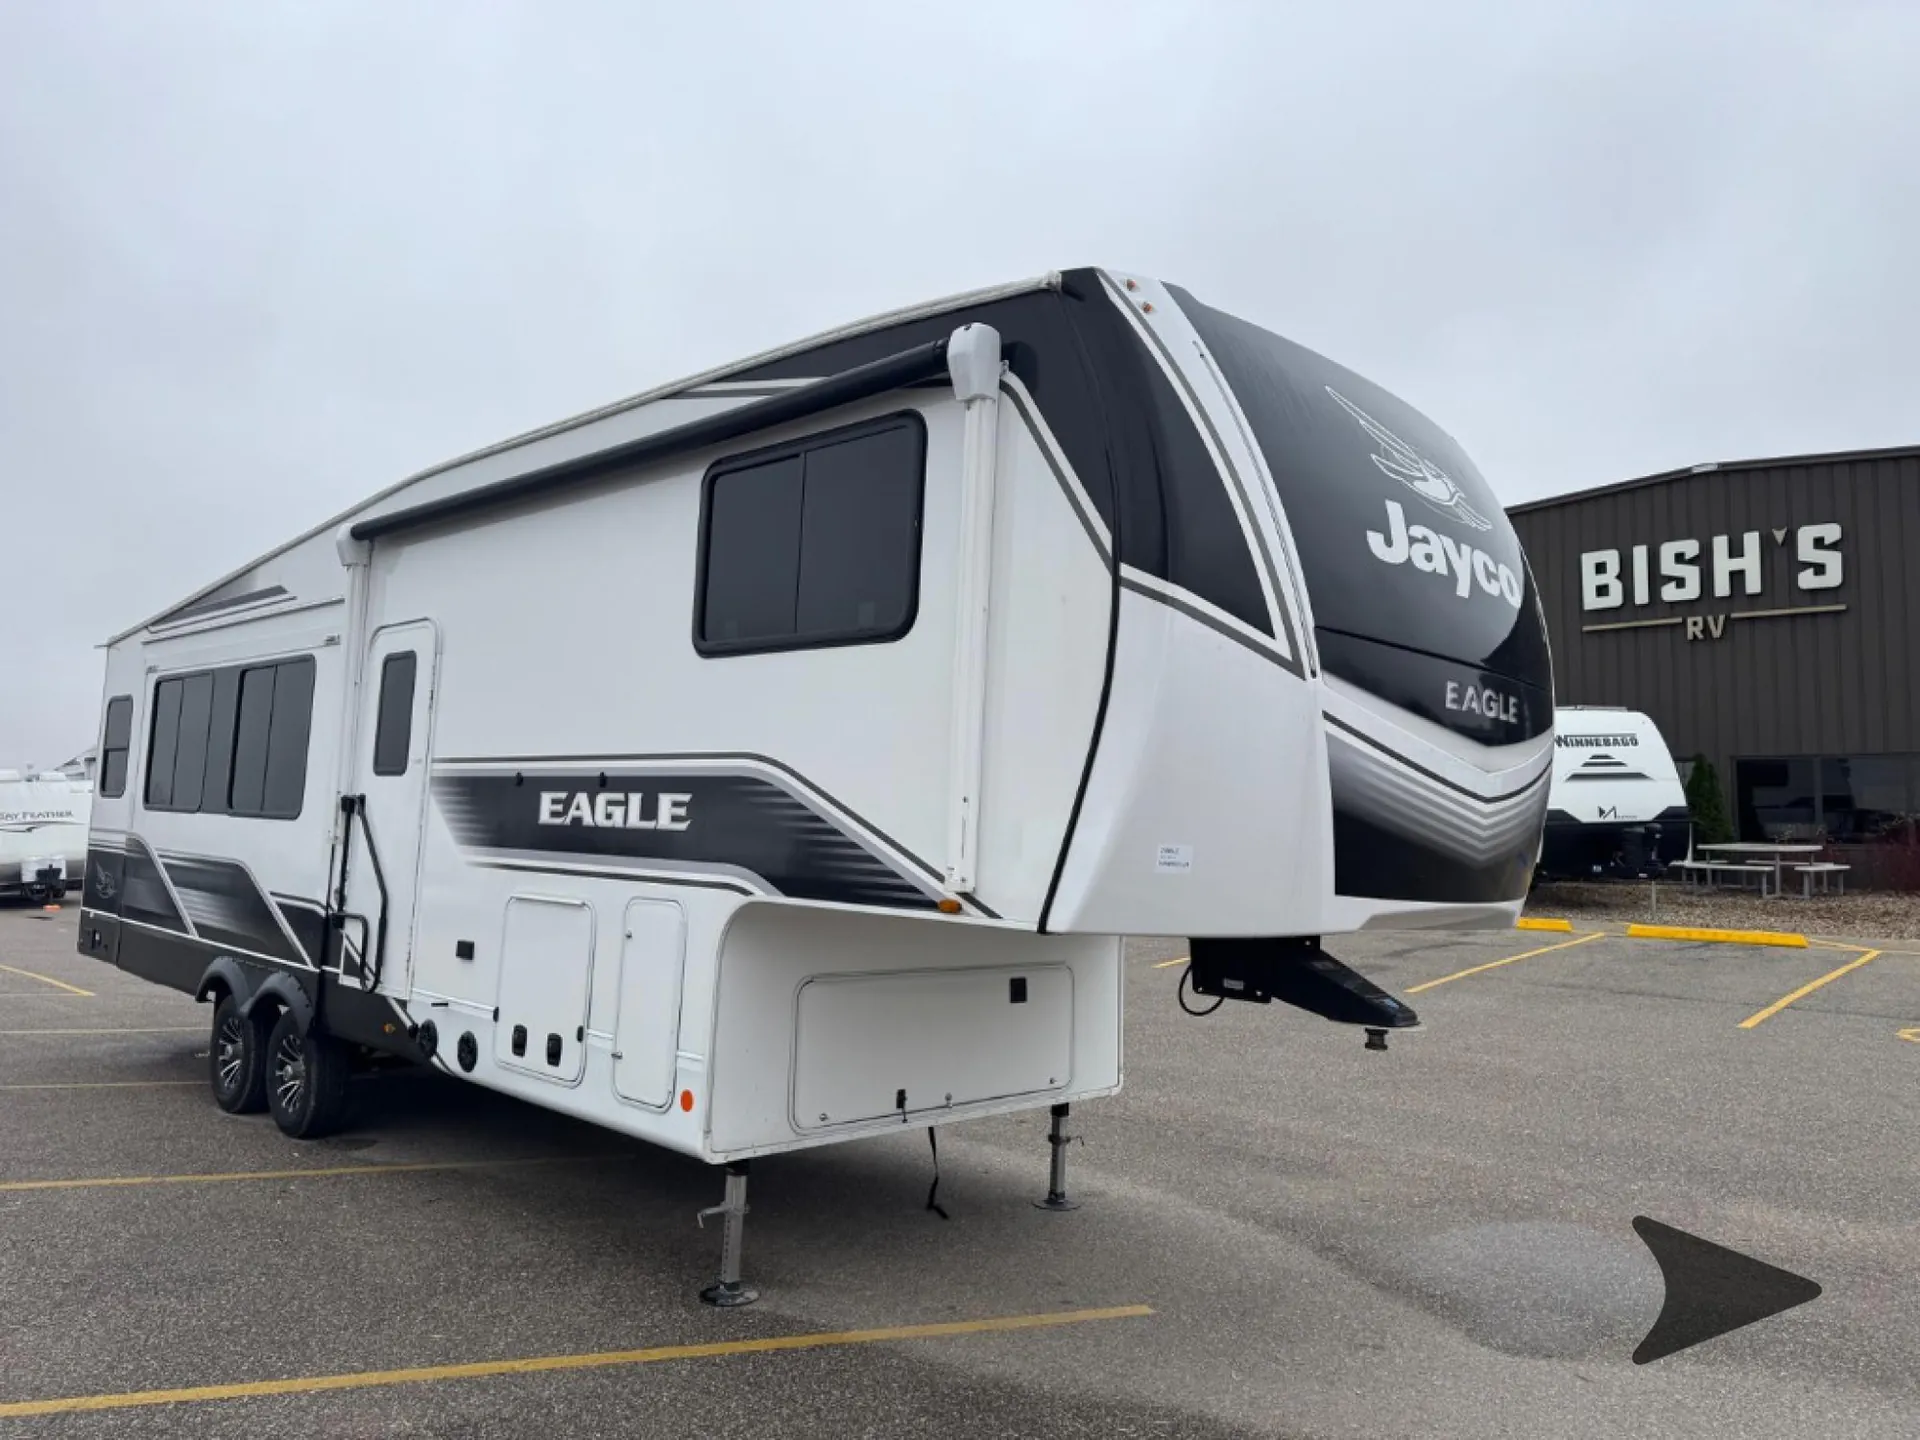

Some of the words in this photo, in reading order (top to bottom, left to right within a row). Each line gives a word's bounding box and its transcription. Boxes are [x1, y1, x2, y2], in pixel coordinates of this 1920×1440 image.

[1366, 499, 1523, 609] Jayco
[1581, 522, 1844, 611] BISH'S
[1686, 614, 1726, 641] RV
[1445, 680, 1519, 724] EAGLE
[22, 809, 74, 820] FEATHER
[538, 790, 693, 832] EAGLE
